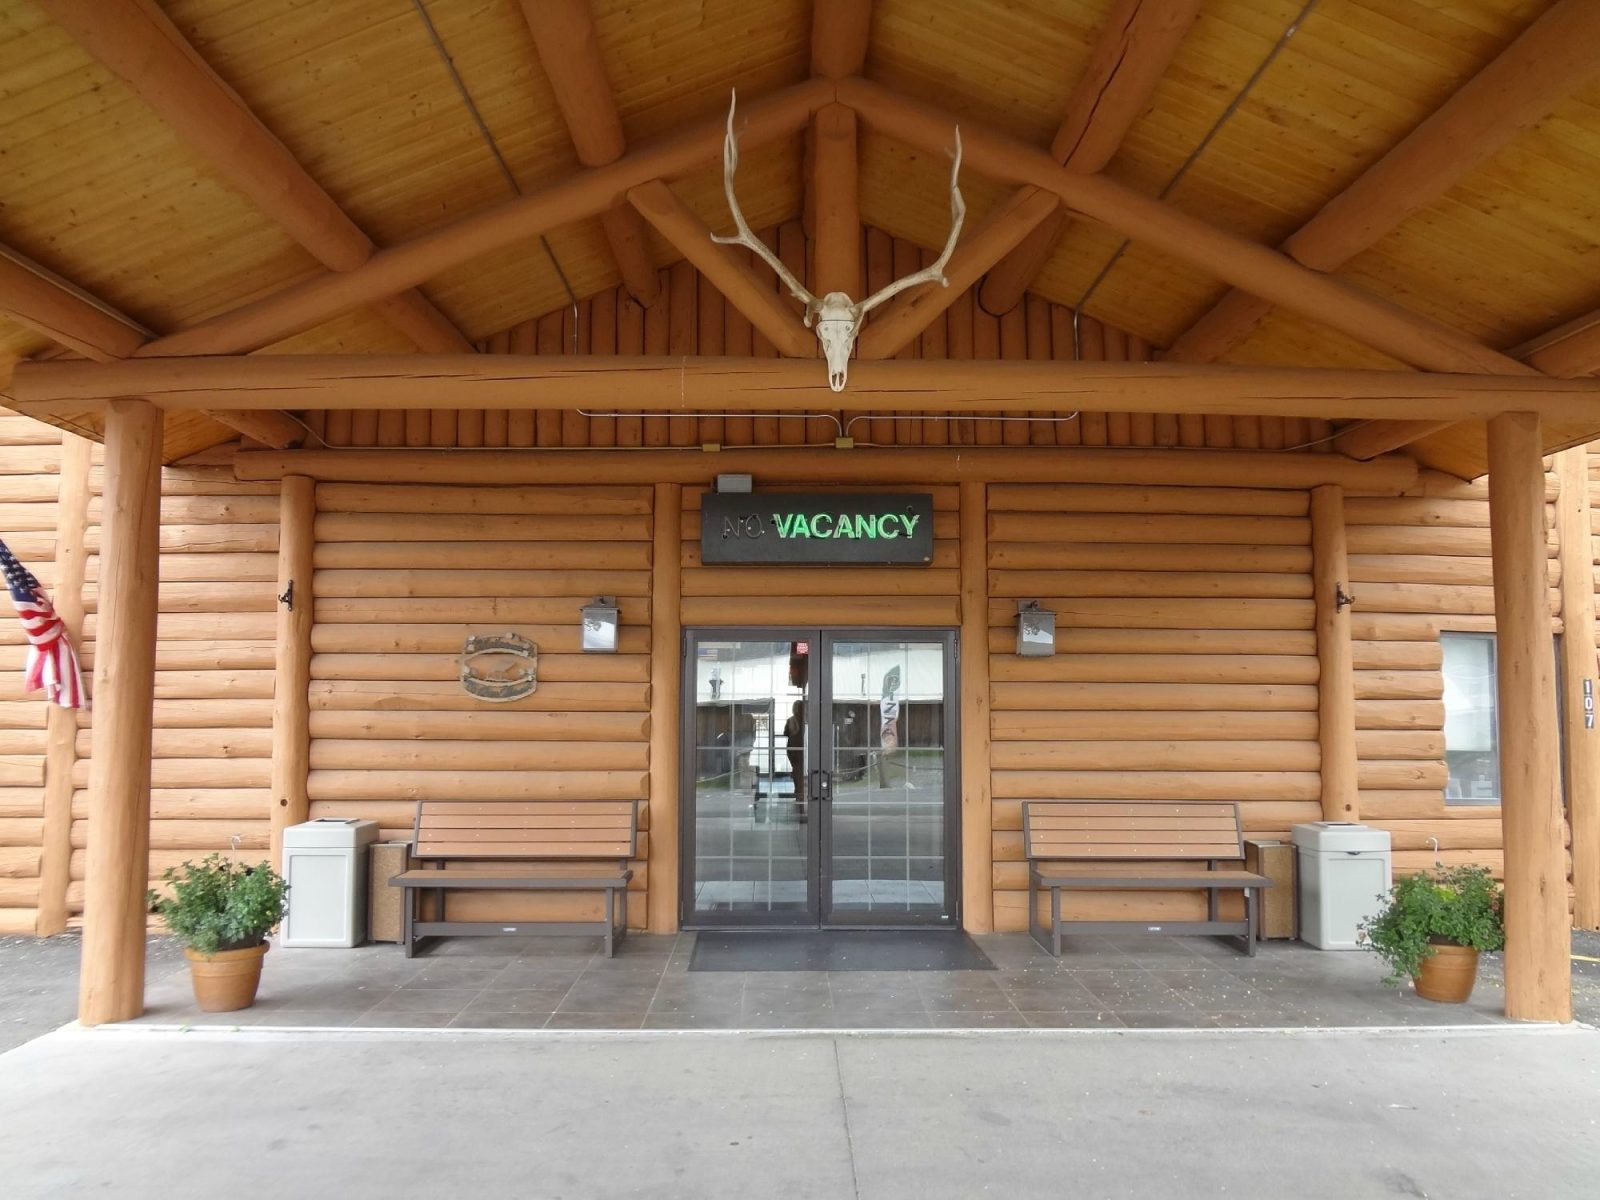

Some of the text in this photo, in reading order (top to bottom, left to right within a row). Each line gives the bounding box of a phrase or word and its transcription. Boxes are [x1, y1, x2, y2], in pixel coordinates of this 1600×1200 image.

[723, 513, 920, 539] NO VACANCY
[1584, 680, 1594, 728] 107
